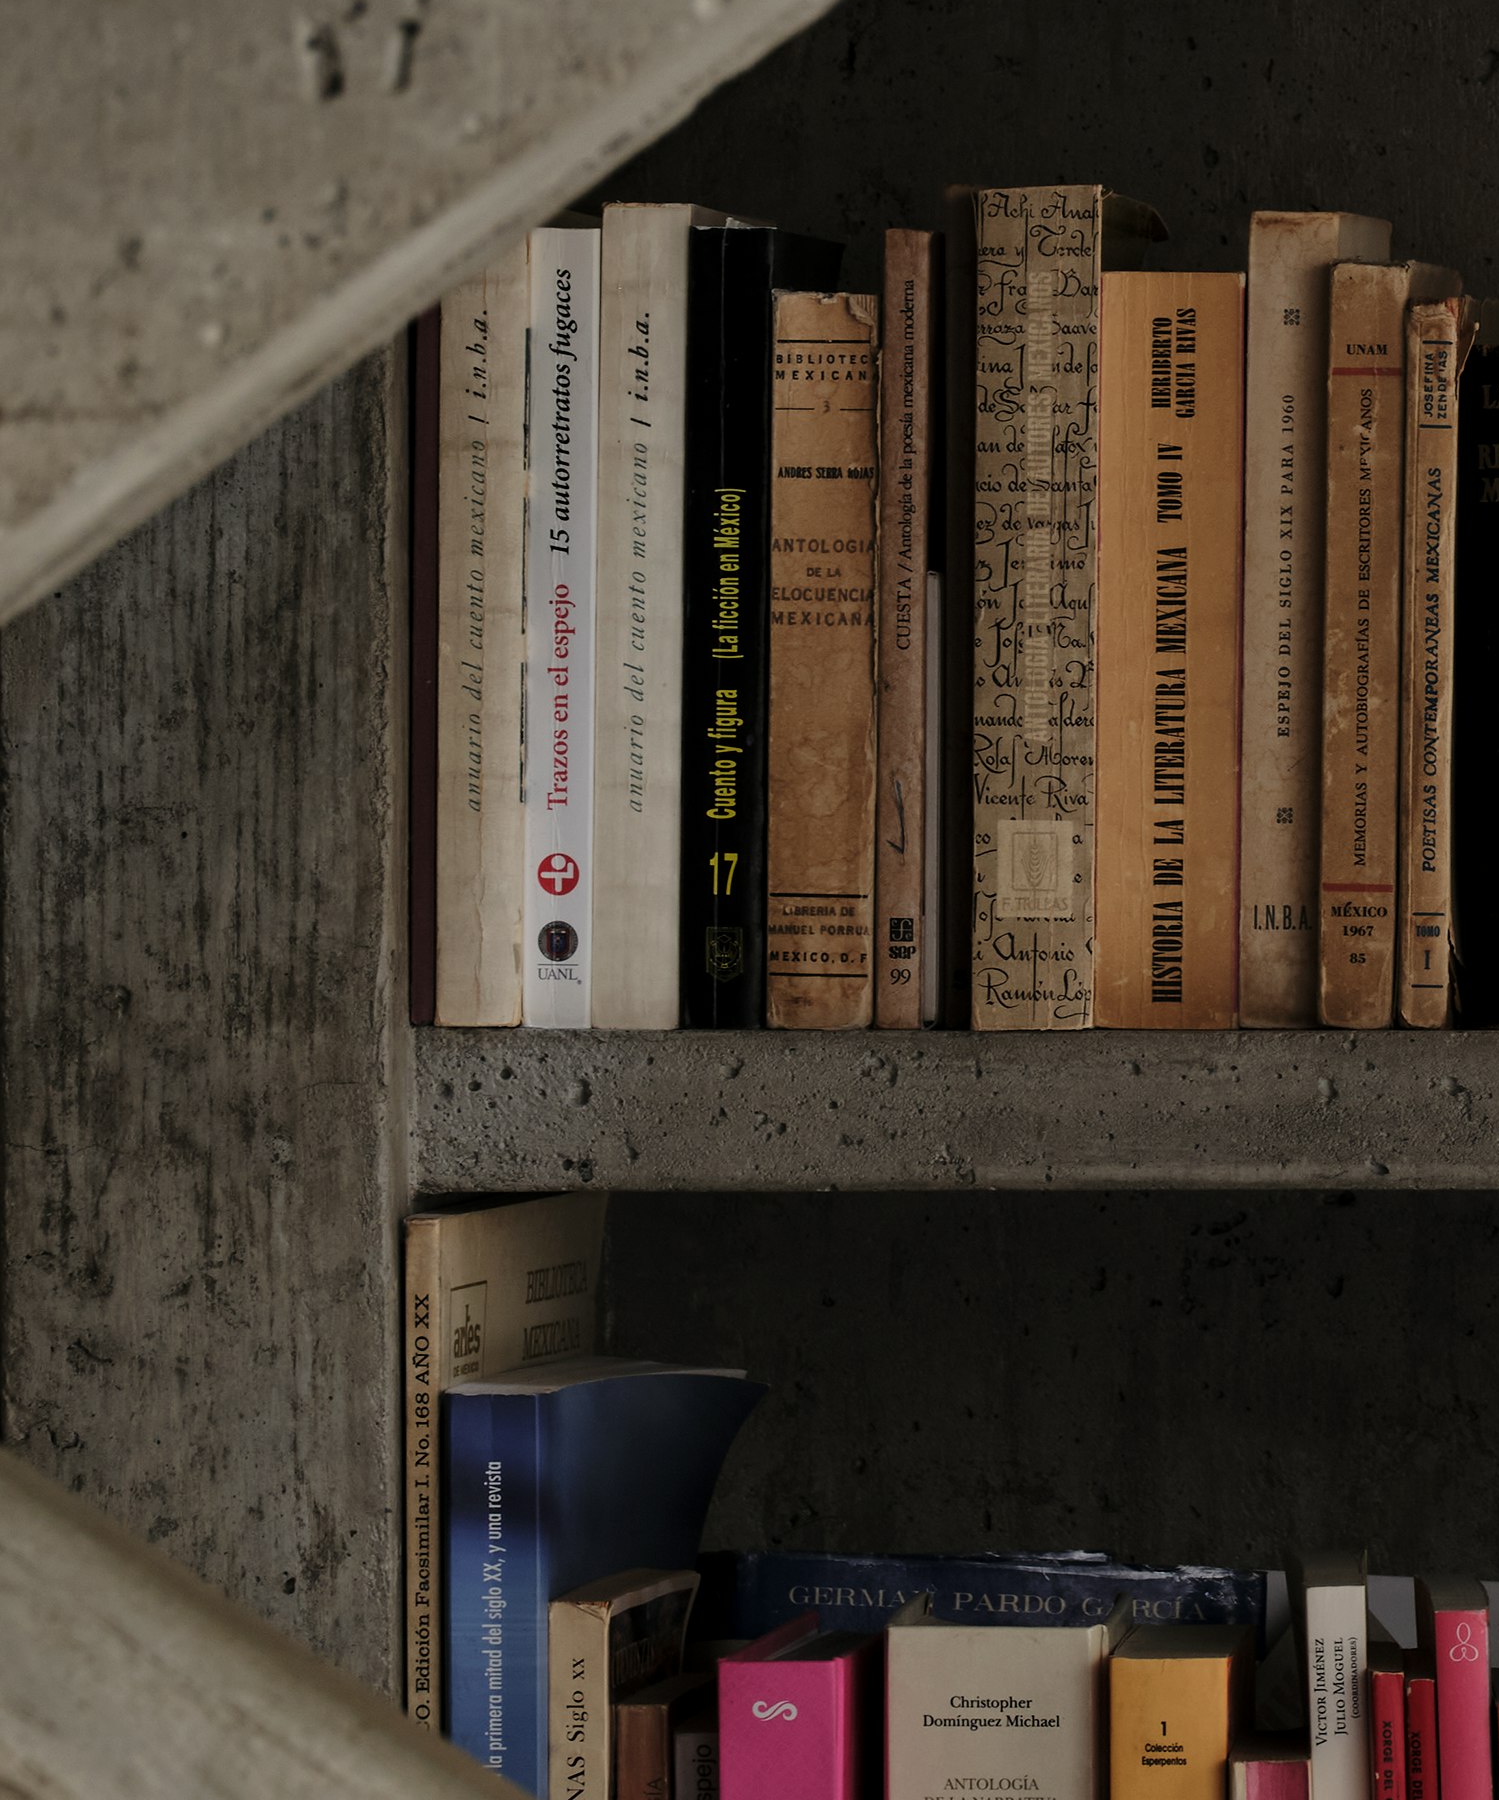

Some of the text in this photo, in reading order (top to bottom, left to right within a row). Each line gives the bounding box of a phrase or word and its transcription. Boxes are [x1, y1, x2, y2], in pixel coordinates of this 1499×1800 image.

[549, 269, 577, 555] 15 autorretratos fugaces
[547, 583, 576, 810] Trazos en el espejo
[705, 689, 744, 820] Cuento y figura
[1152, 547, 1187, 1004] HISTORIA DE LA LITERATURA MEXICANA
[709, 852, 739, 895] 17
